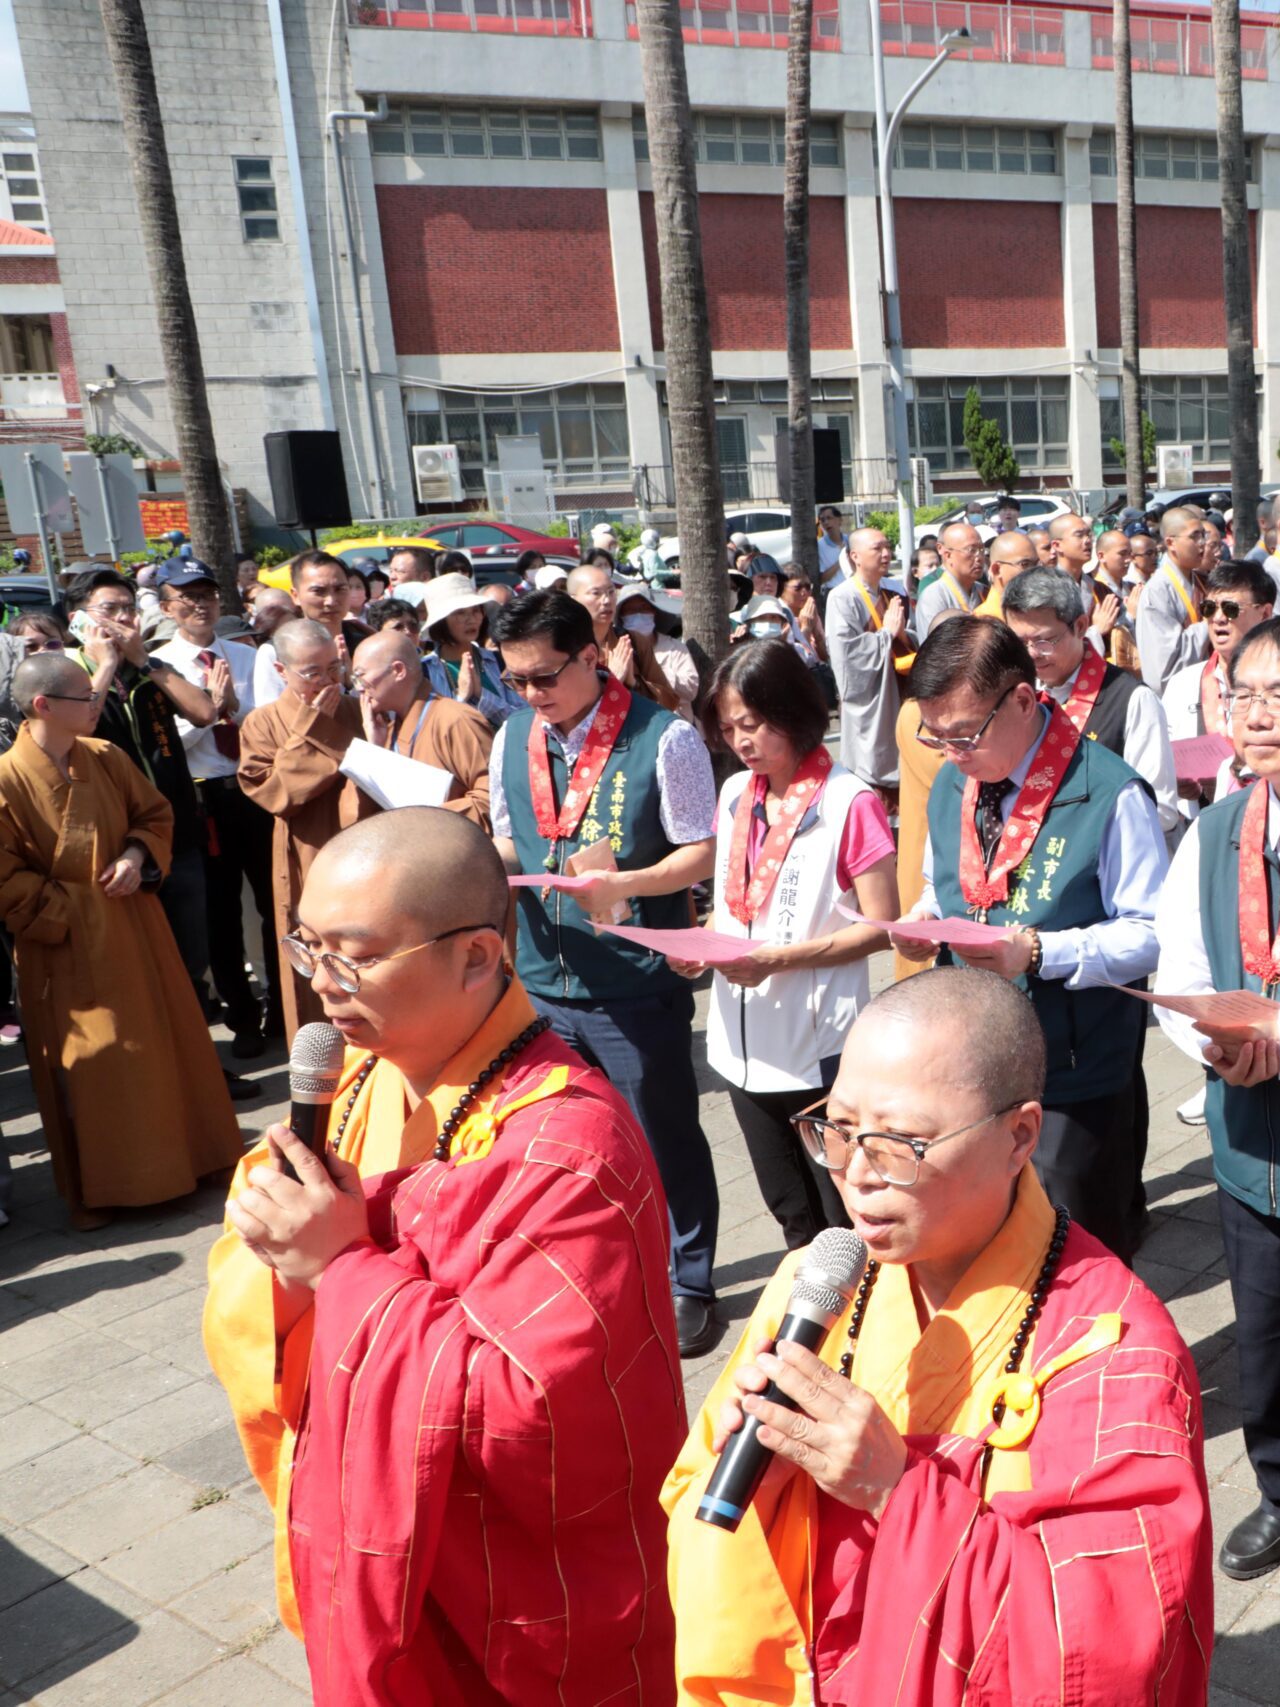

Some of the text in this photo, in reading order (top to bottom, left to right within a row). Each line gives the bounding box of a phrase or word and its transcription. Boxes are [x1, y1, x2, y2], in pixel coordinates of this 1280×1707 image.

[607, 771, 627, 852] 臺南市政府
[778, 867, 800, 927] 謝龍介
[1036, 836, 1067, 901] 副市長
